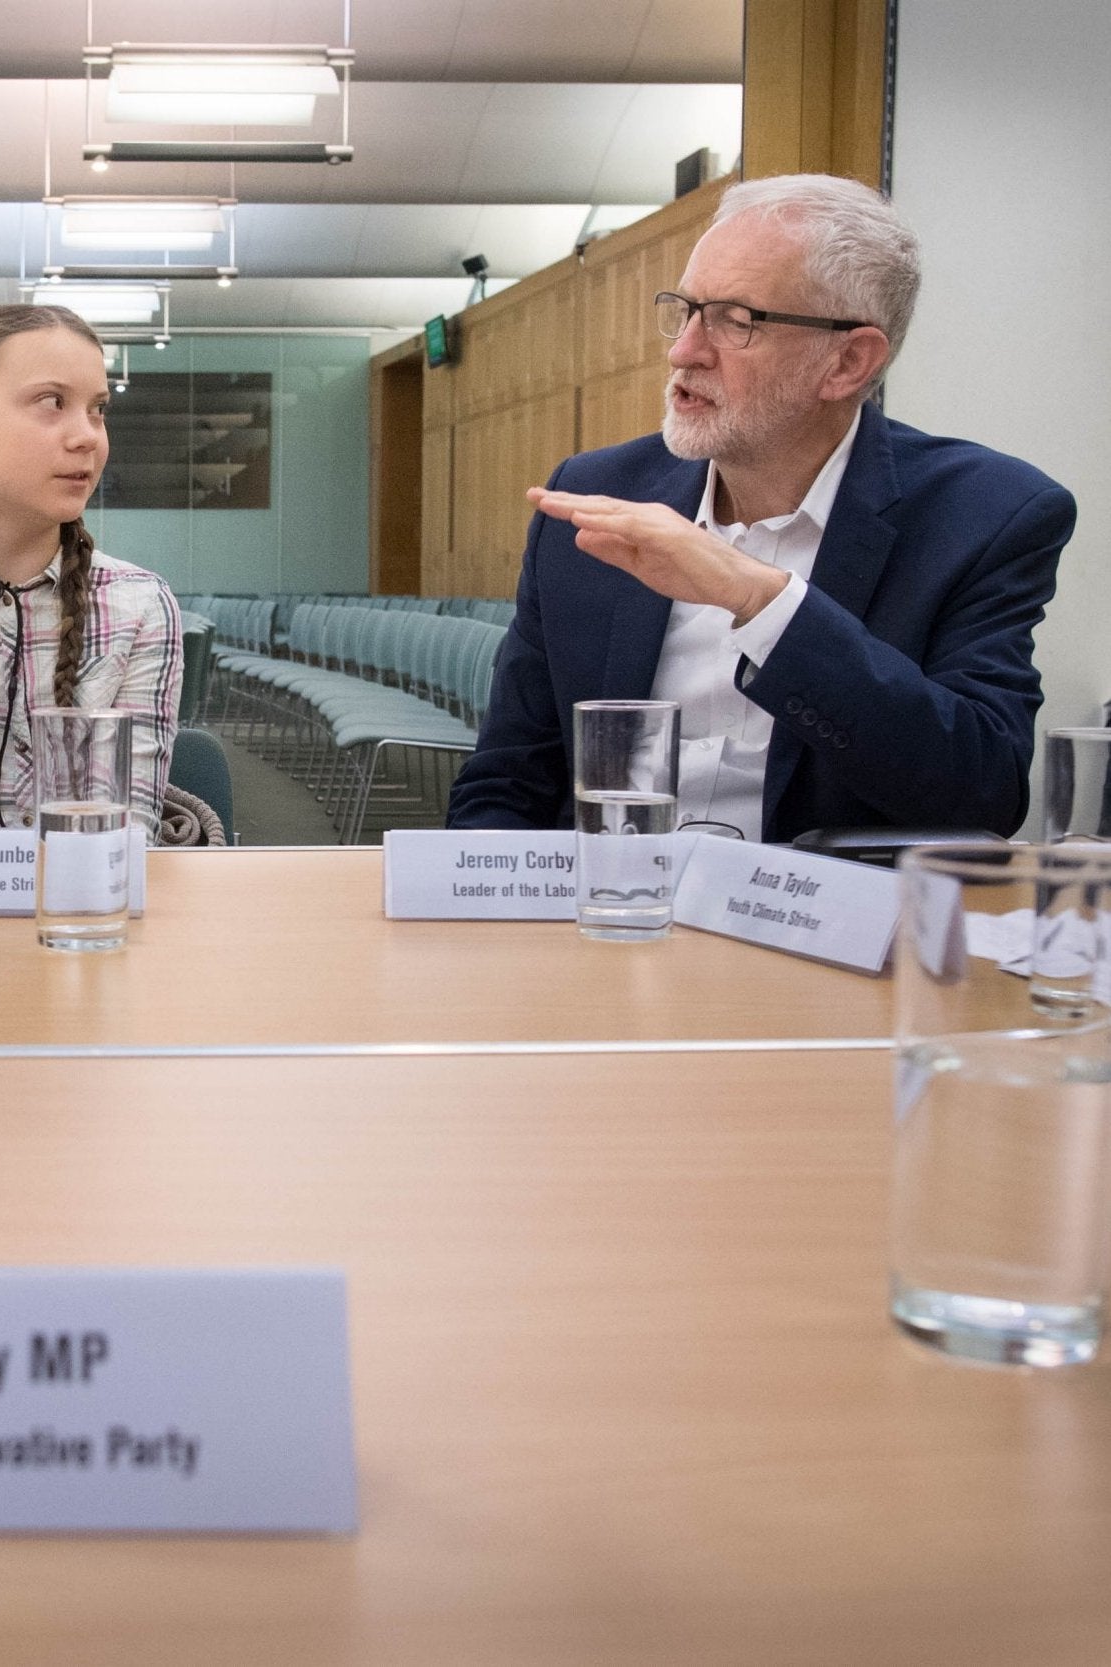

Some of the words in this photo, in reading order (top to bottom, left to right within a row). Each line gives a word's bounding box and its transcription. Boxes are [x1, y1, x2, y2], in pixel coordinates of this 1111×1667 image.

[455, 850, 518, 872] Jeremy
[525, 850, 575, 872] Corby
[11, 877, 34, 891] Stri
[453, 882, 496, 897] Leader
[501, 882, 514, 897] of
[519, 882, 539, 897] the
[545, 882, 576, 897] Labo
[749, 866, 781, 890] Anna
[783, 872, 821, 898] Taylor
[727, 896, 751, 915] Youth
[751, 902, 786, 923] Climate
[787, 910, 821, 930] Striker
[28, 1328, 109, 1384] MP
[105, 1423, 199, 1478] Party
